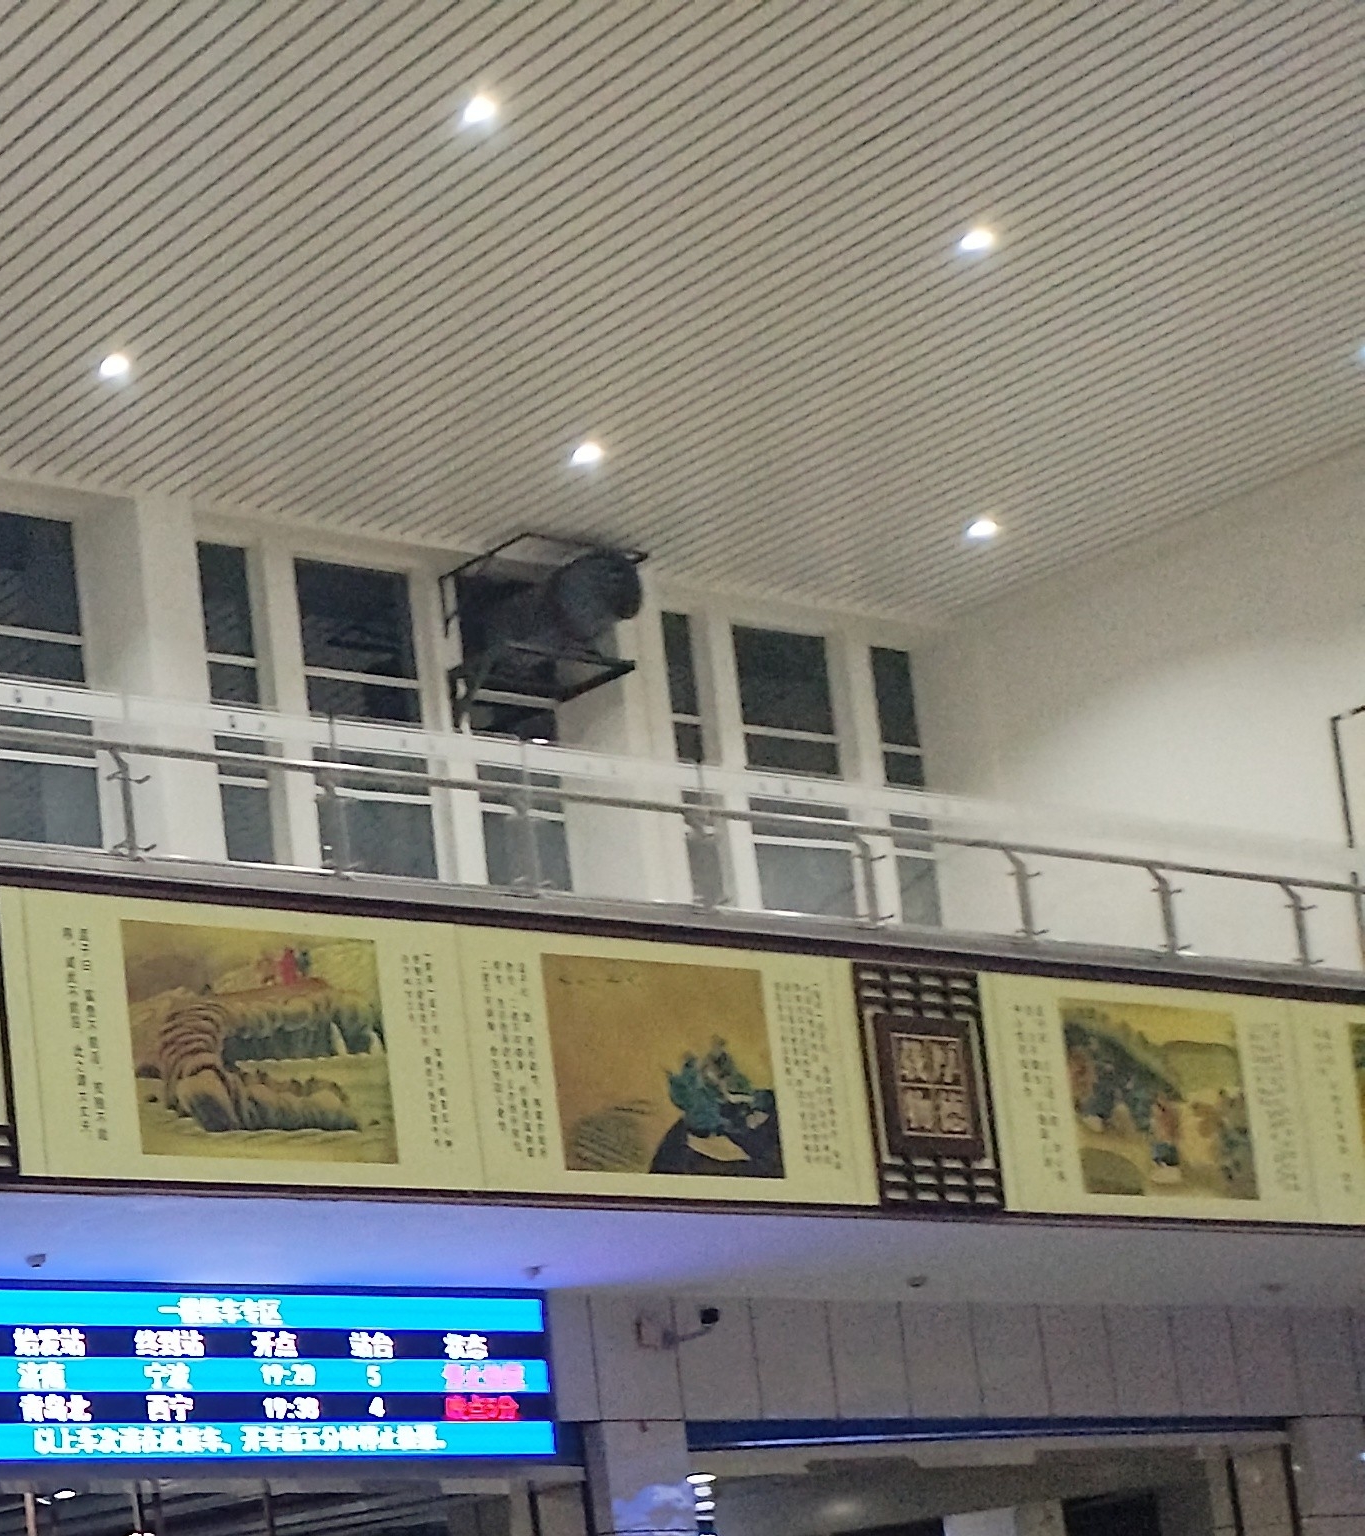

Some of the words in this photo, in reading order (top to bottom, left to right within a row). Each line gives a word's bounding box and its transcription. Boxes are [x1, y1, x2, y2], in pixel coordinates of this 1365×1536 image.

[13, 1328, 86, 1357] 始发站
[134, 1329, 205, 1357] 终到站
[251, 1331, 298, 1358] 开点
[349, 1332, 393, 1359] 站台
[366, 1365, 382, 1388] 5
[145, 1394, 194, 1422] 西宁
[368, 1396, 386, 1418] 4
